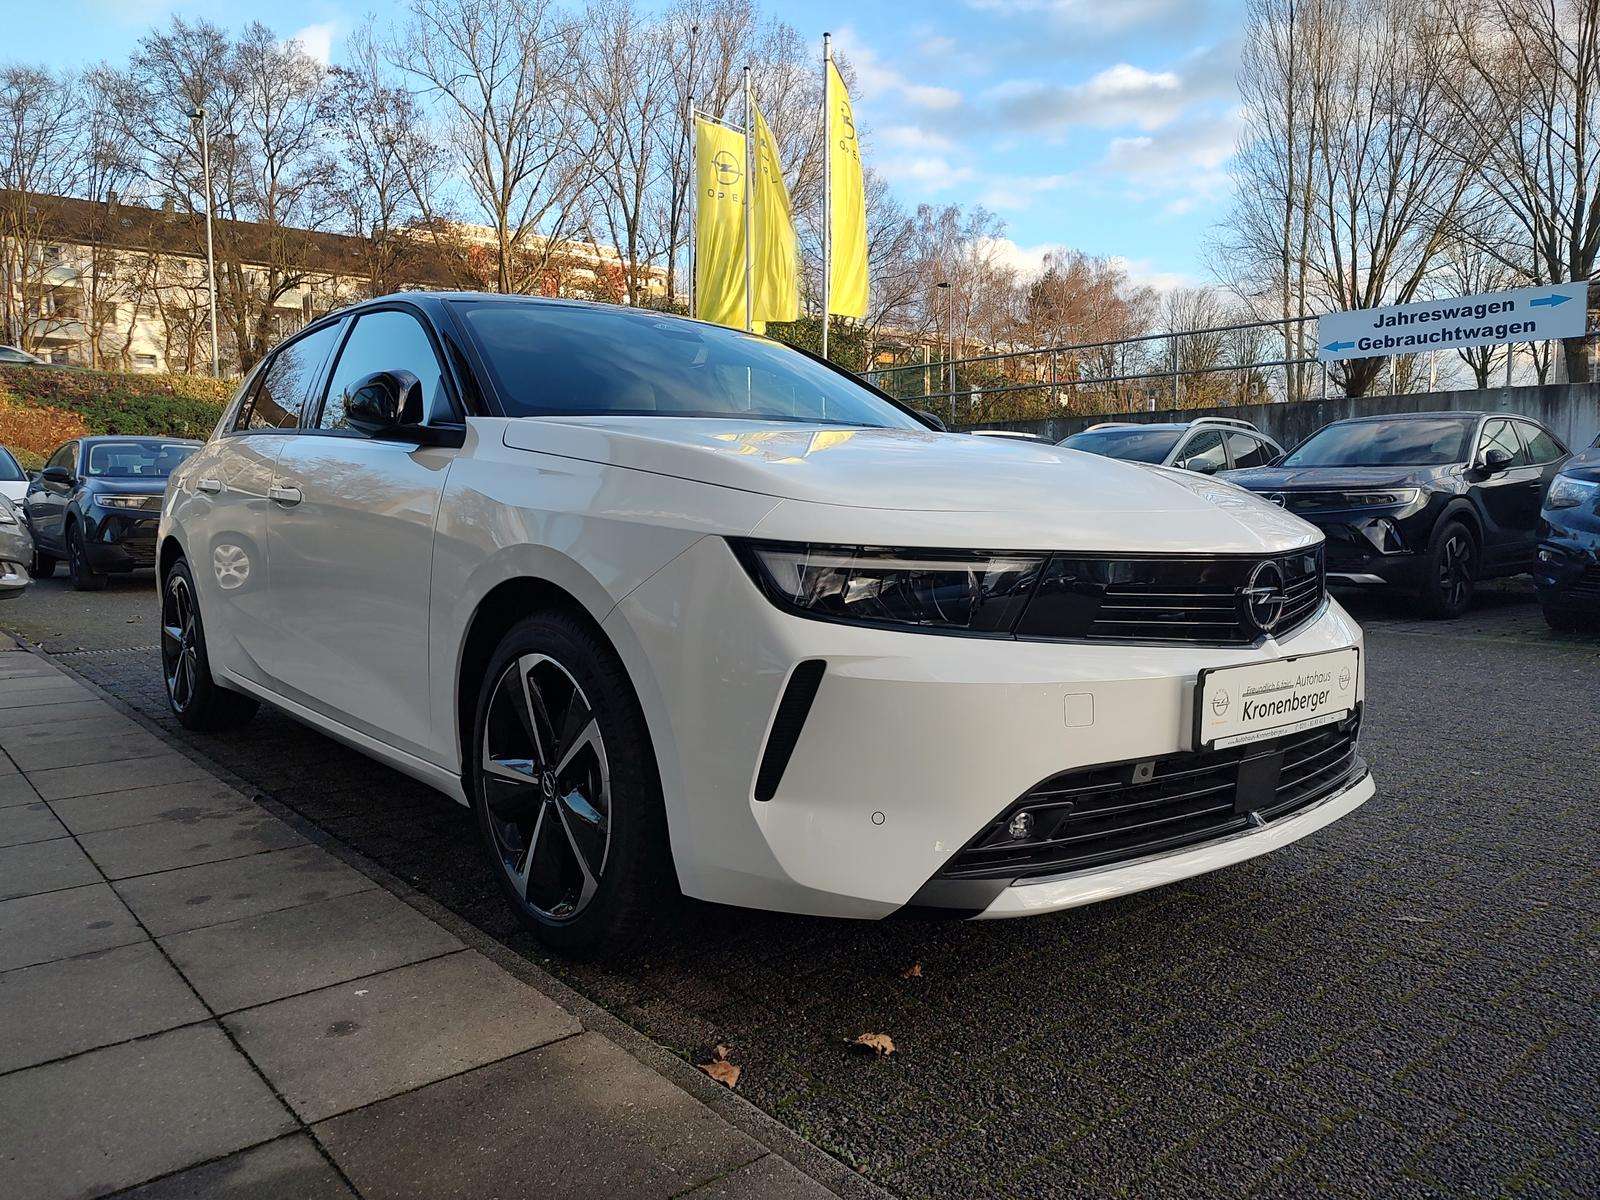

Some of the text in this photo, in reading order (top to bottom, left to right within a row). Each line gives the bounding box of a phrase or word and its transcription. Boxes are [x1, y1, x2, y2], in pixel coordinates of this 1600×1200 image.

[1373, 299, 1515, 329] Jahreswagen
[1357, 320, 1536, 351] Gebrauchtwagen
[1295, 671, 1331, 687] Autohaus
[1242, 690, 1330, 721] Kronenberger
